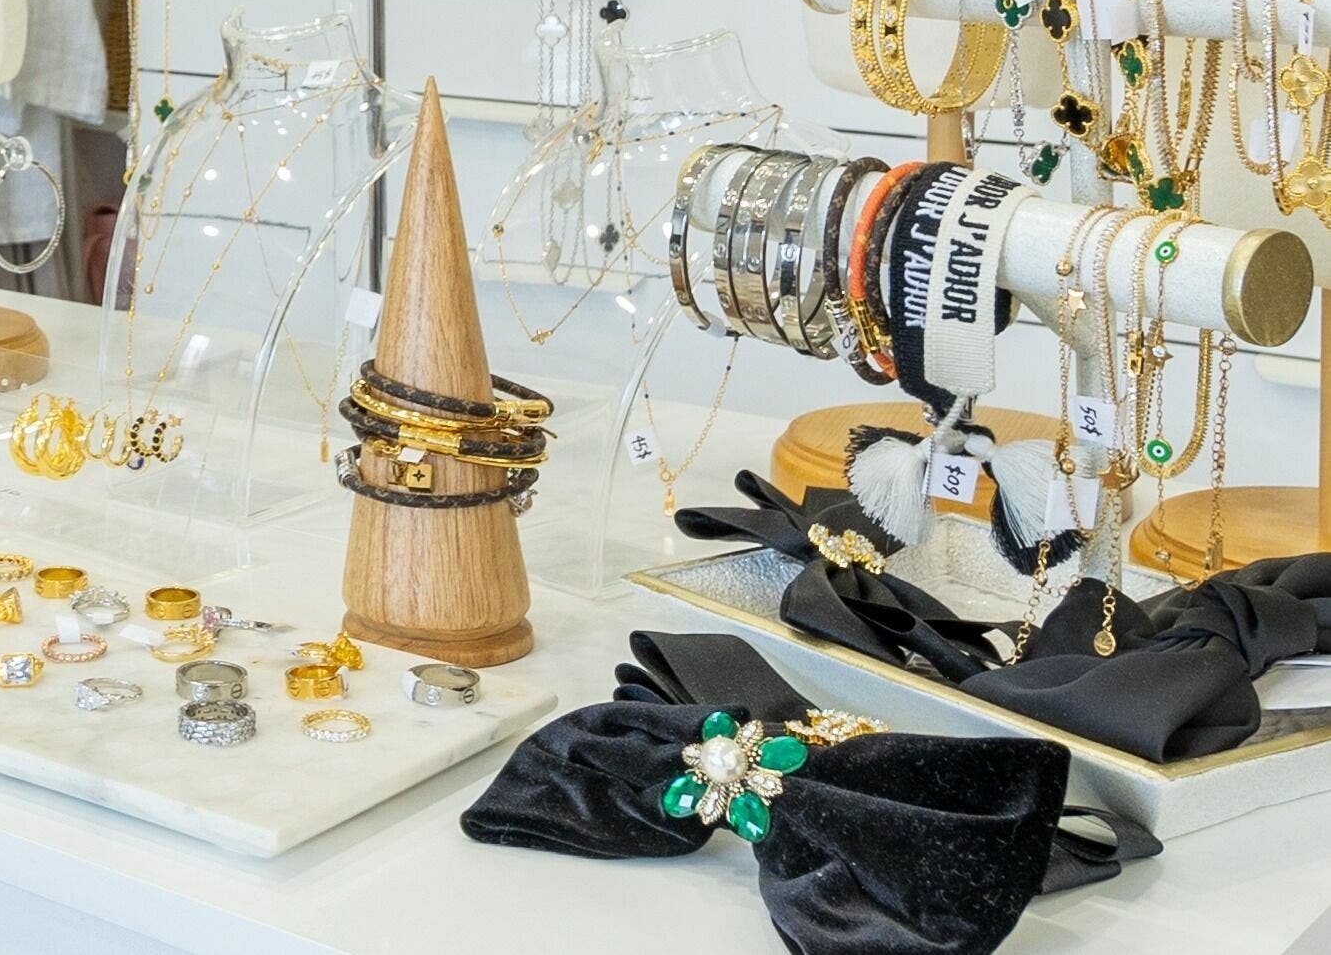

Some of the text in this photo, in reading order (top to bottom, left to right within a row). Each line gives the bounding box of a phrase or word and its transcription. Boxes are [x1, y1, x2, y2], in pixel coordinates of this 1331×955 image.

[941, 211, 990, 324] J'ADIOR
[1079, 405, 1102, 436] 50$
[943, 463, 966, 496] 60$
